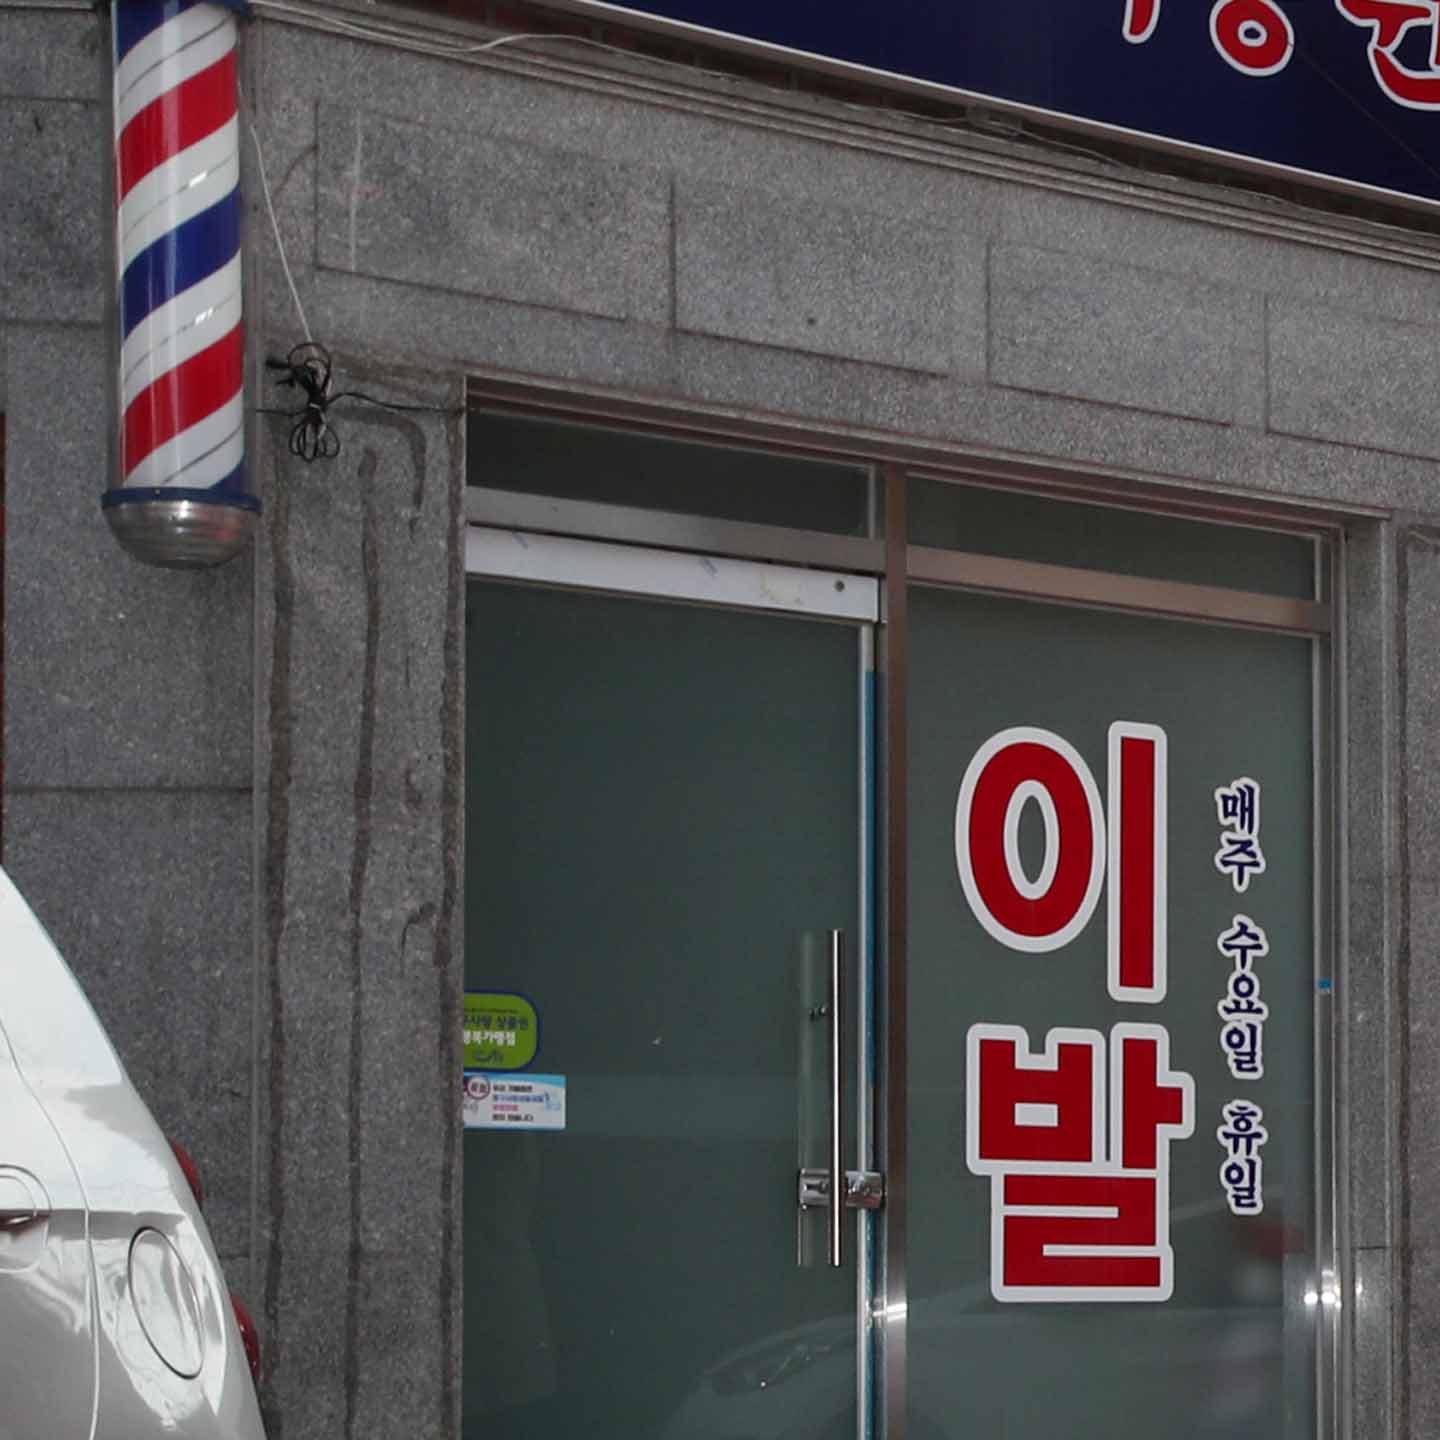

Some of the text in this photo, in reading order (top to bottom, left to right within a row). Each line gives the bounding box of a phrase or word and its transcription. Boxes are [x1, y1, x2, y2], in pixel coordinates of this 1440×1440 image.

[955, 721, 1195, 1301] 이발
[1216, 777, 1267, 1215] 매주 수요일 휴일
